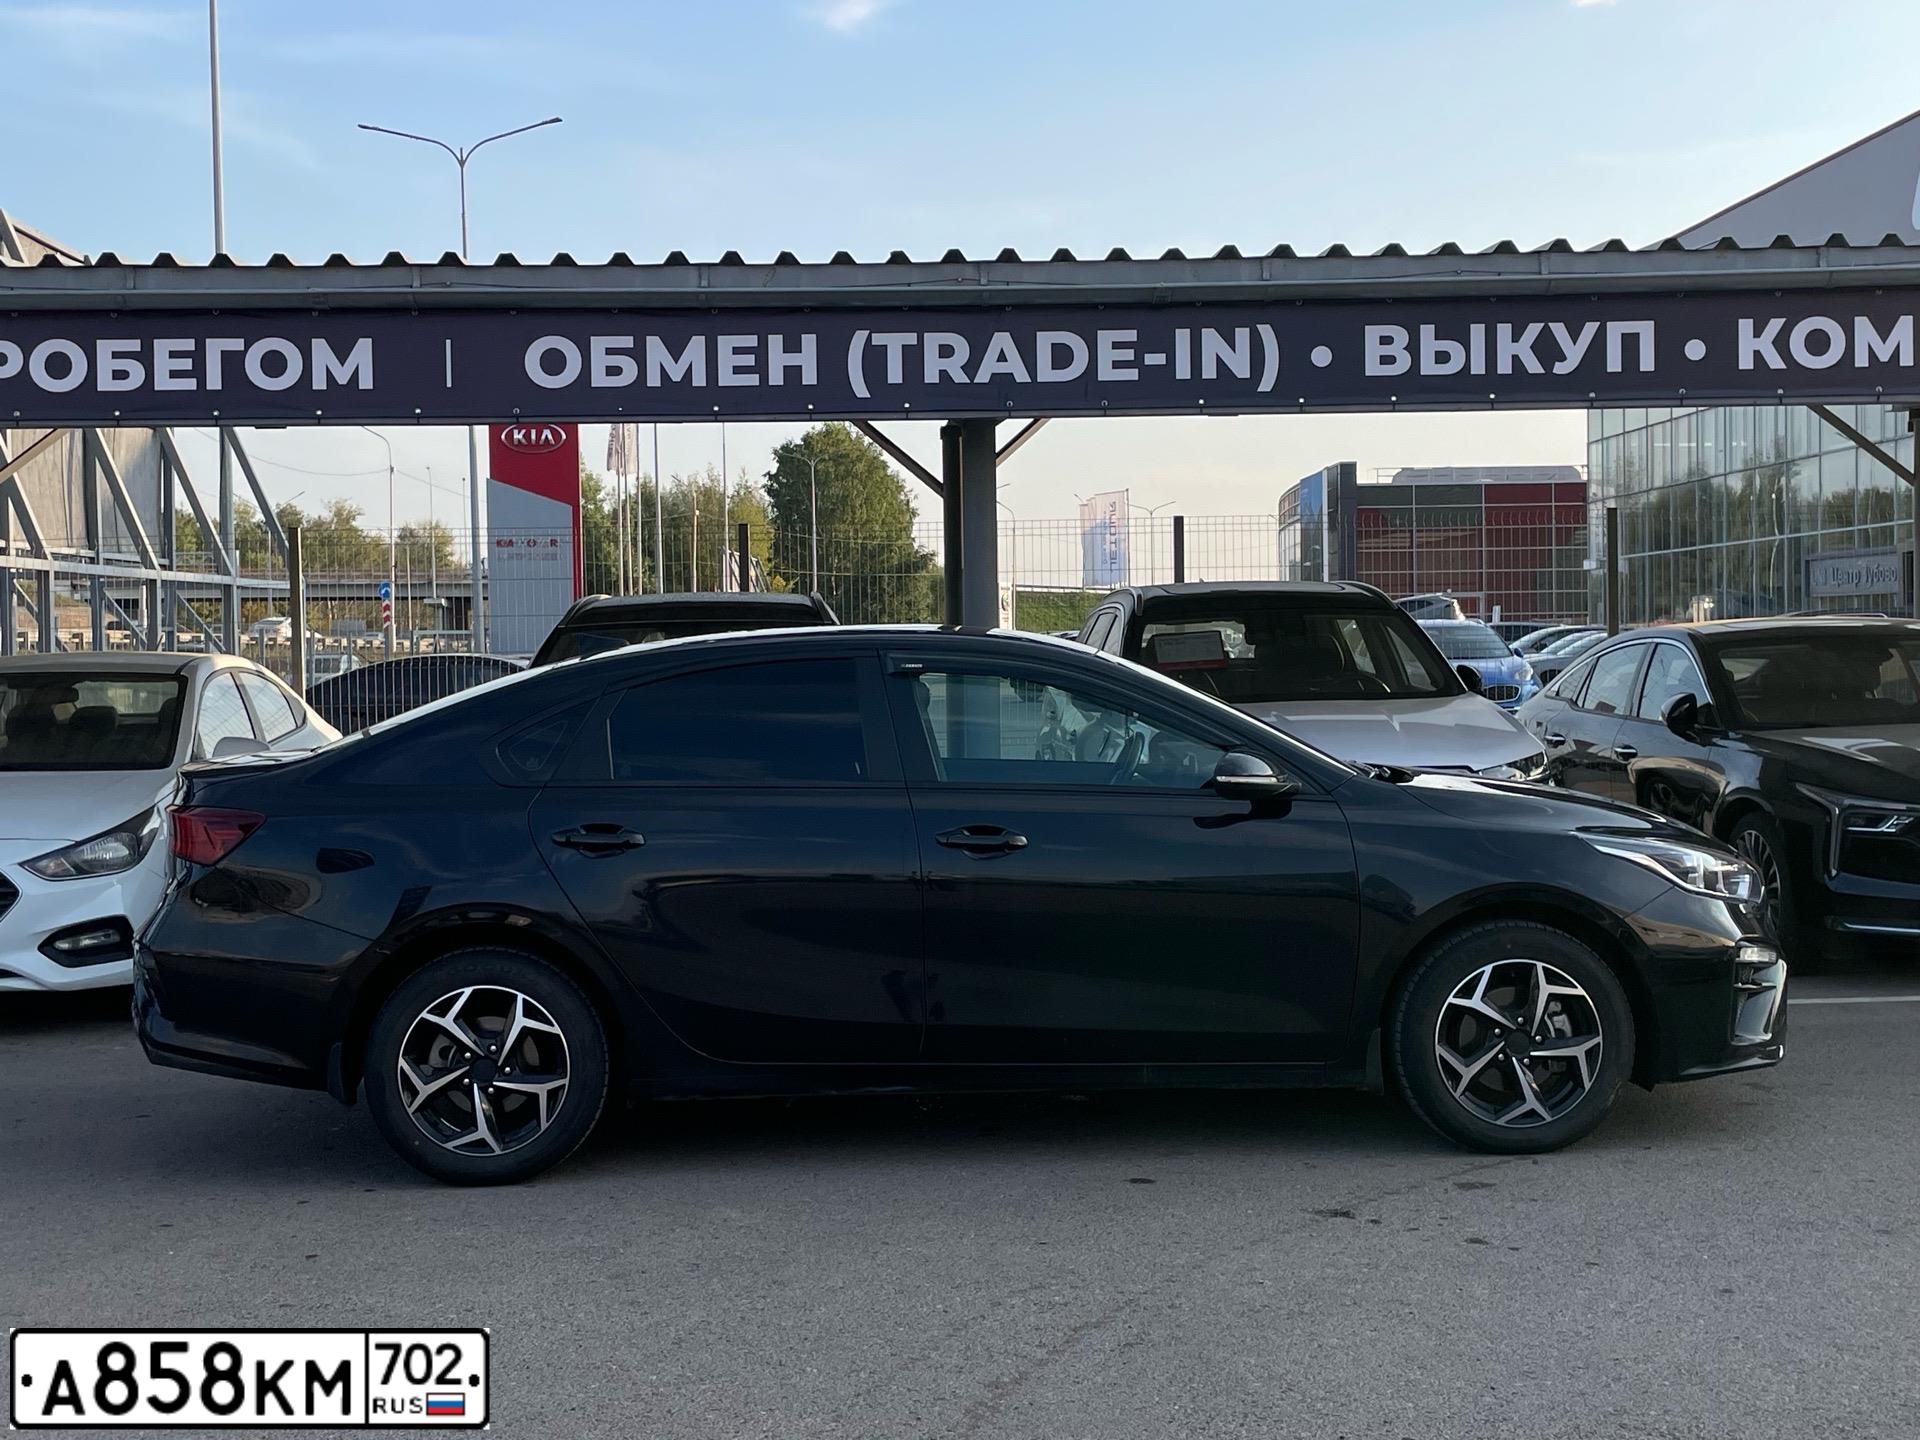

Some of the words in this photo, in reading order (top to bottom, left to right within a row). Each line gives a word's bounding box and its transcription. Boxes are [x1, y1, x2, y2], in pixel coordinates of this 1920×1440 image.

[525, 334, 817, 388] ОБМЕН
[847, 324, 1279, 398] (TRADE-IN)
[1365, 321, 1654, 376] ВЫКУП
[1738, 315, 1914, 370] КОМ
[513, 428, 555, 446] KIA
